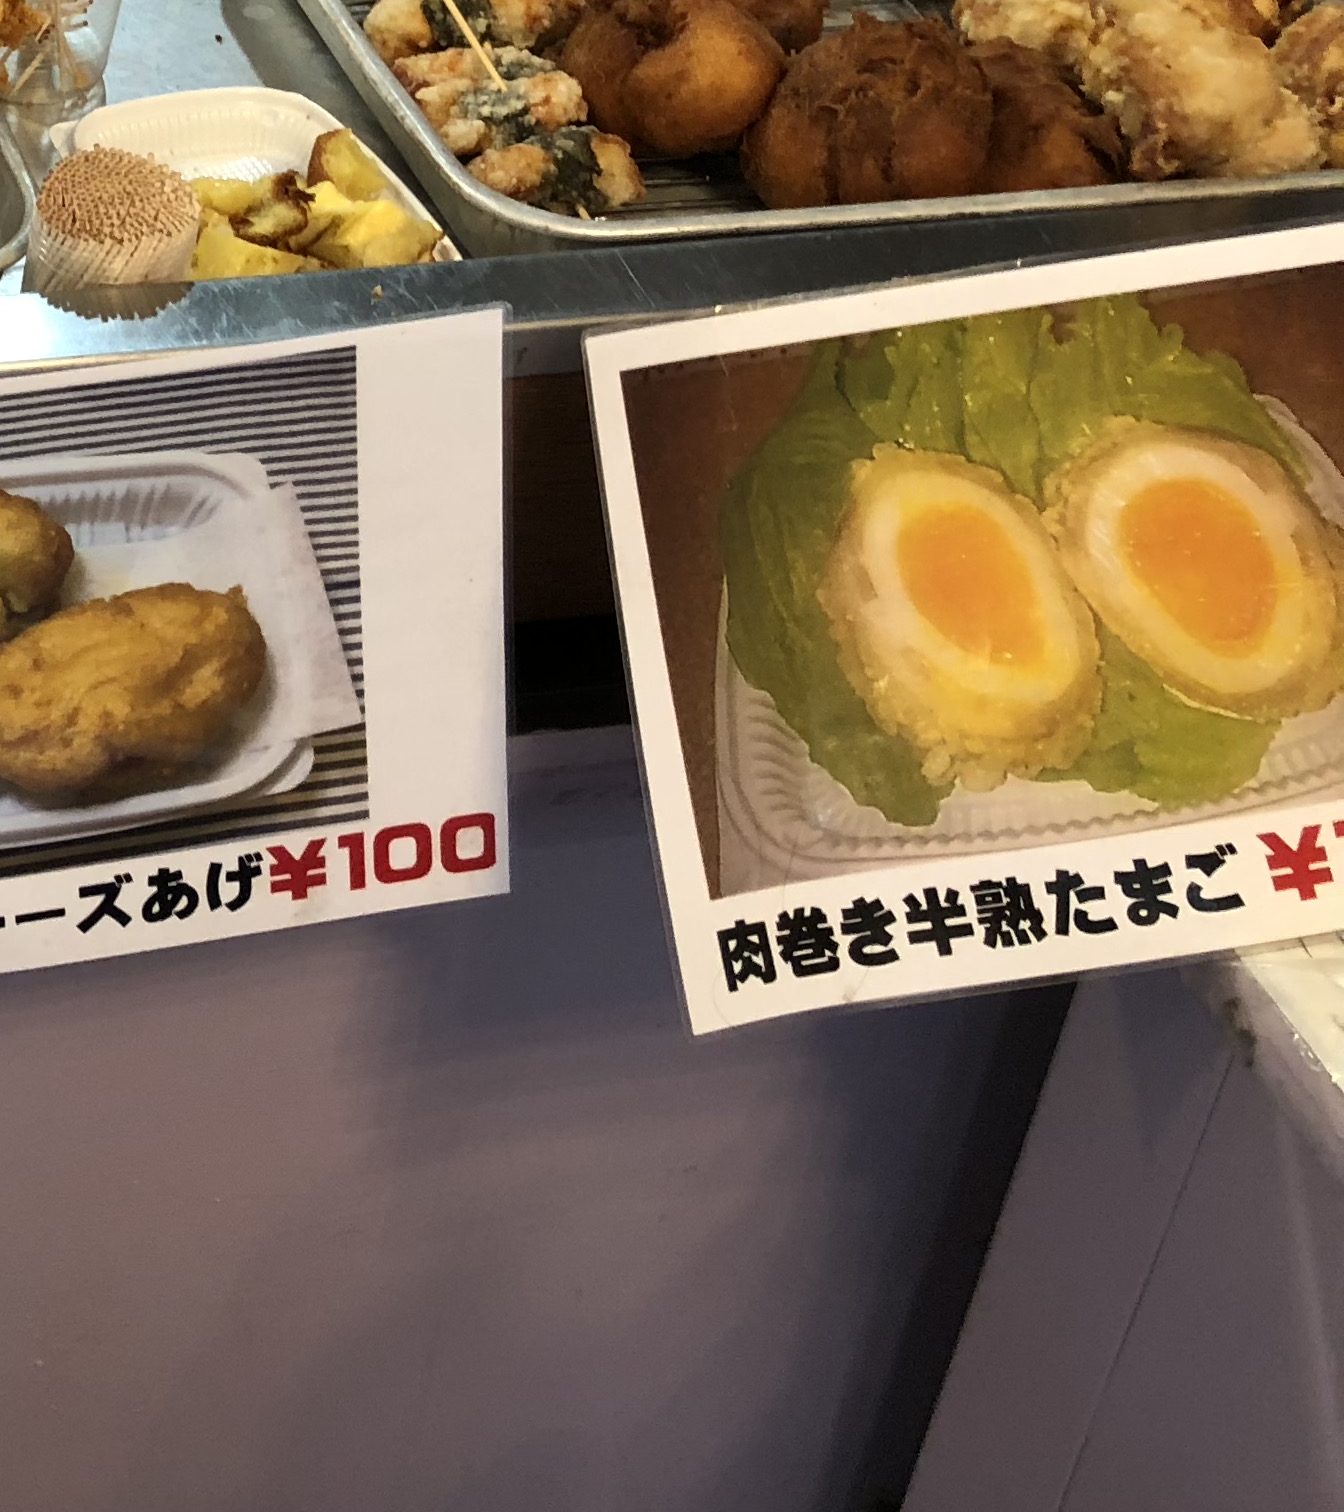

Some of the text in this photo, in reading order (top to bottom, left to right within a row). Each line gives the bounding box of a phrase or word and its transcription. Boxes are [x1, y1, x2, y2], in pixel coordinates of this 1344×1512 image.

[266, 812, 498, 903] ¥100
[716, 841, 1247, 992] 肉巻き半熟たまご
